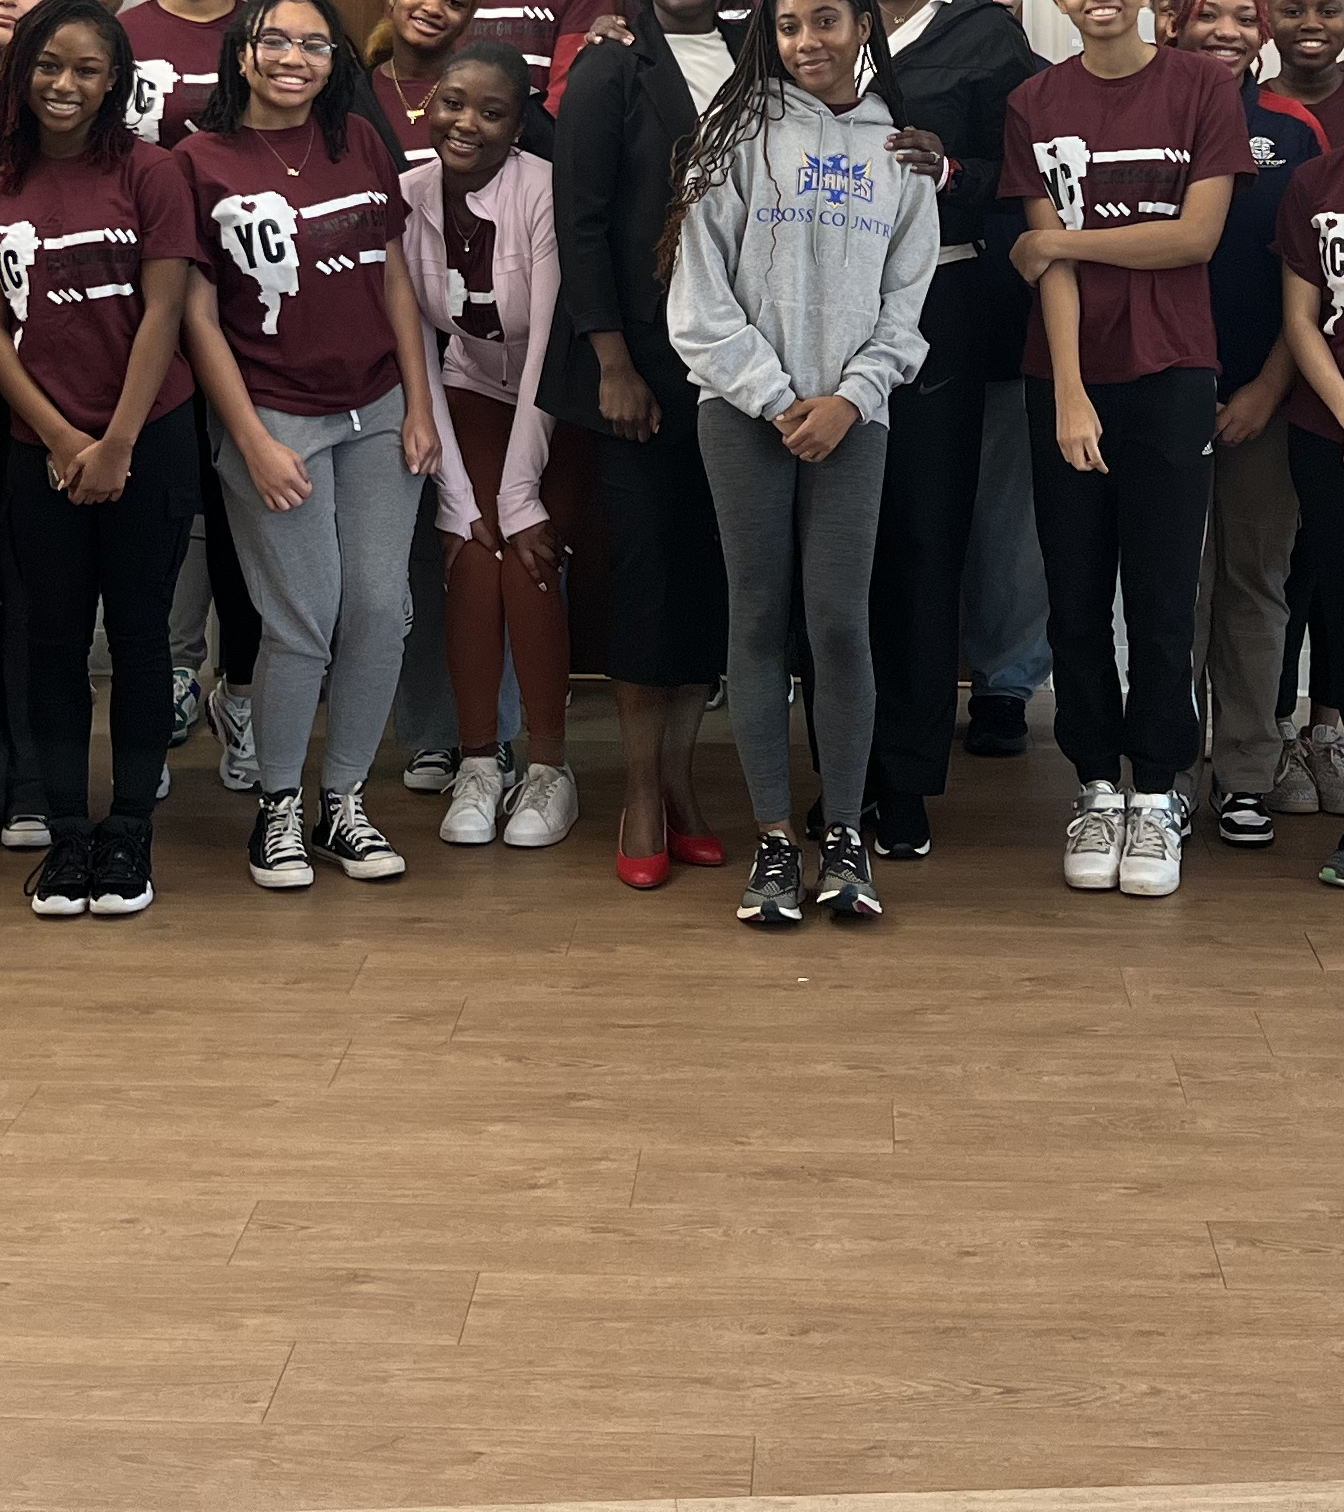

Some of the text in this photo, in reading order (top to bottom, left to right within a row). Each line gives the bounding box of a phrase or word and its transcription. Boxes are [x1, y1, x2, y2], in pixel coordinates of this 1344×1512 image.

[135, 77, 157, 115] C
[799, 168, 872, 201] FLAMES
[756, 207, 894, 239] CROSS COUNTR
[233, 218, 286, 269] YC
